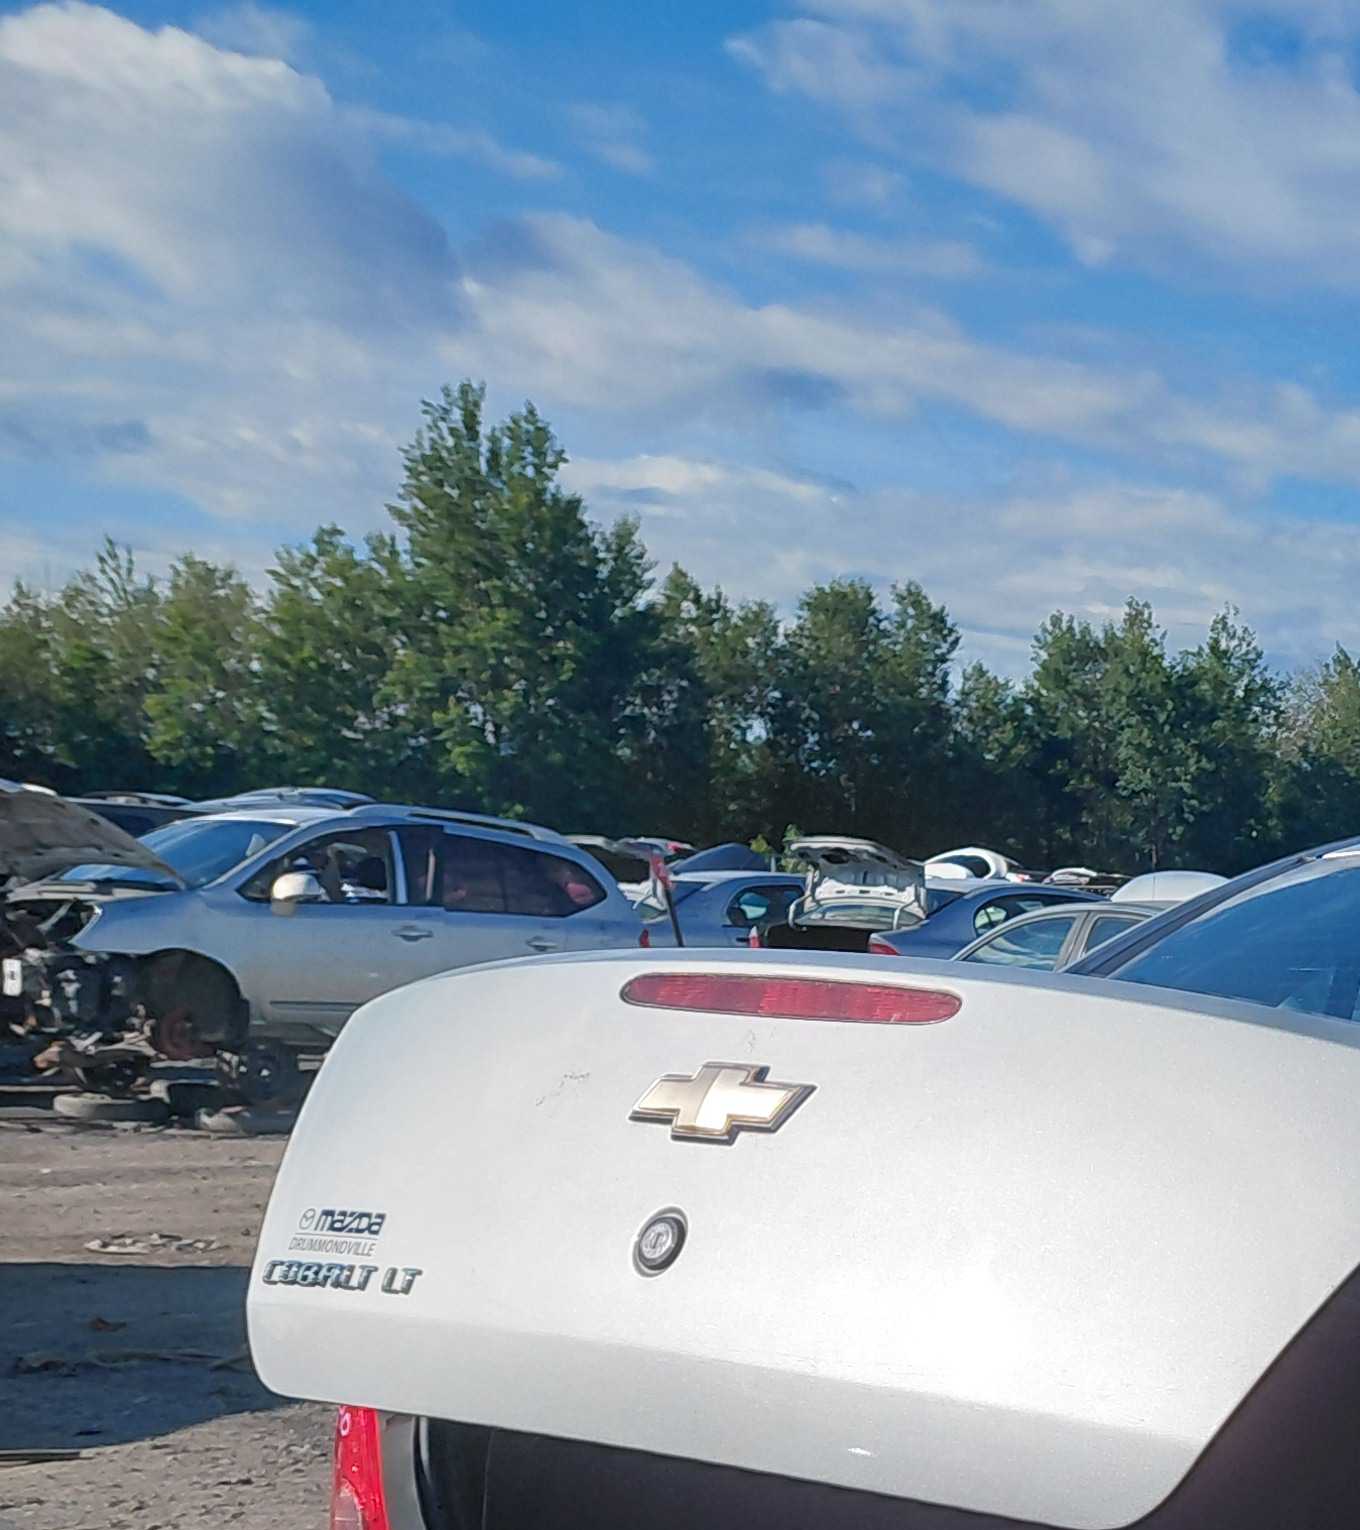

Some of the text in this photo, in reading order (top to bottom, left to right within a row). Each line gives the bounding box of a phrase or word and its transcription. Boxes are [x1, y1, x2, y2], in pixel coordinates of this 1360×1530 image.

[314, 1208, 387, 1236] mazda
[288, 1237, 377, 1257] DRUMMONDVILLE
[262, 1260, 423, 1295] COBALT LT
